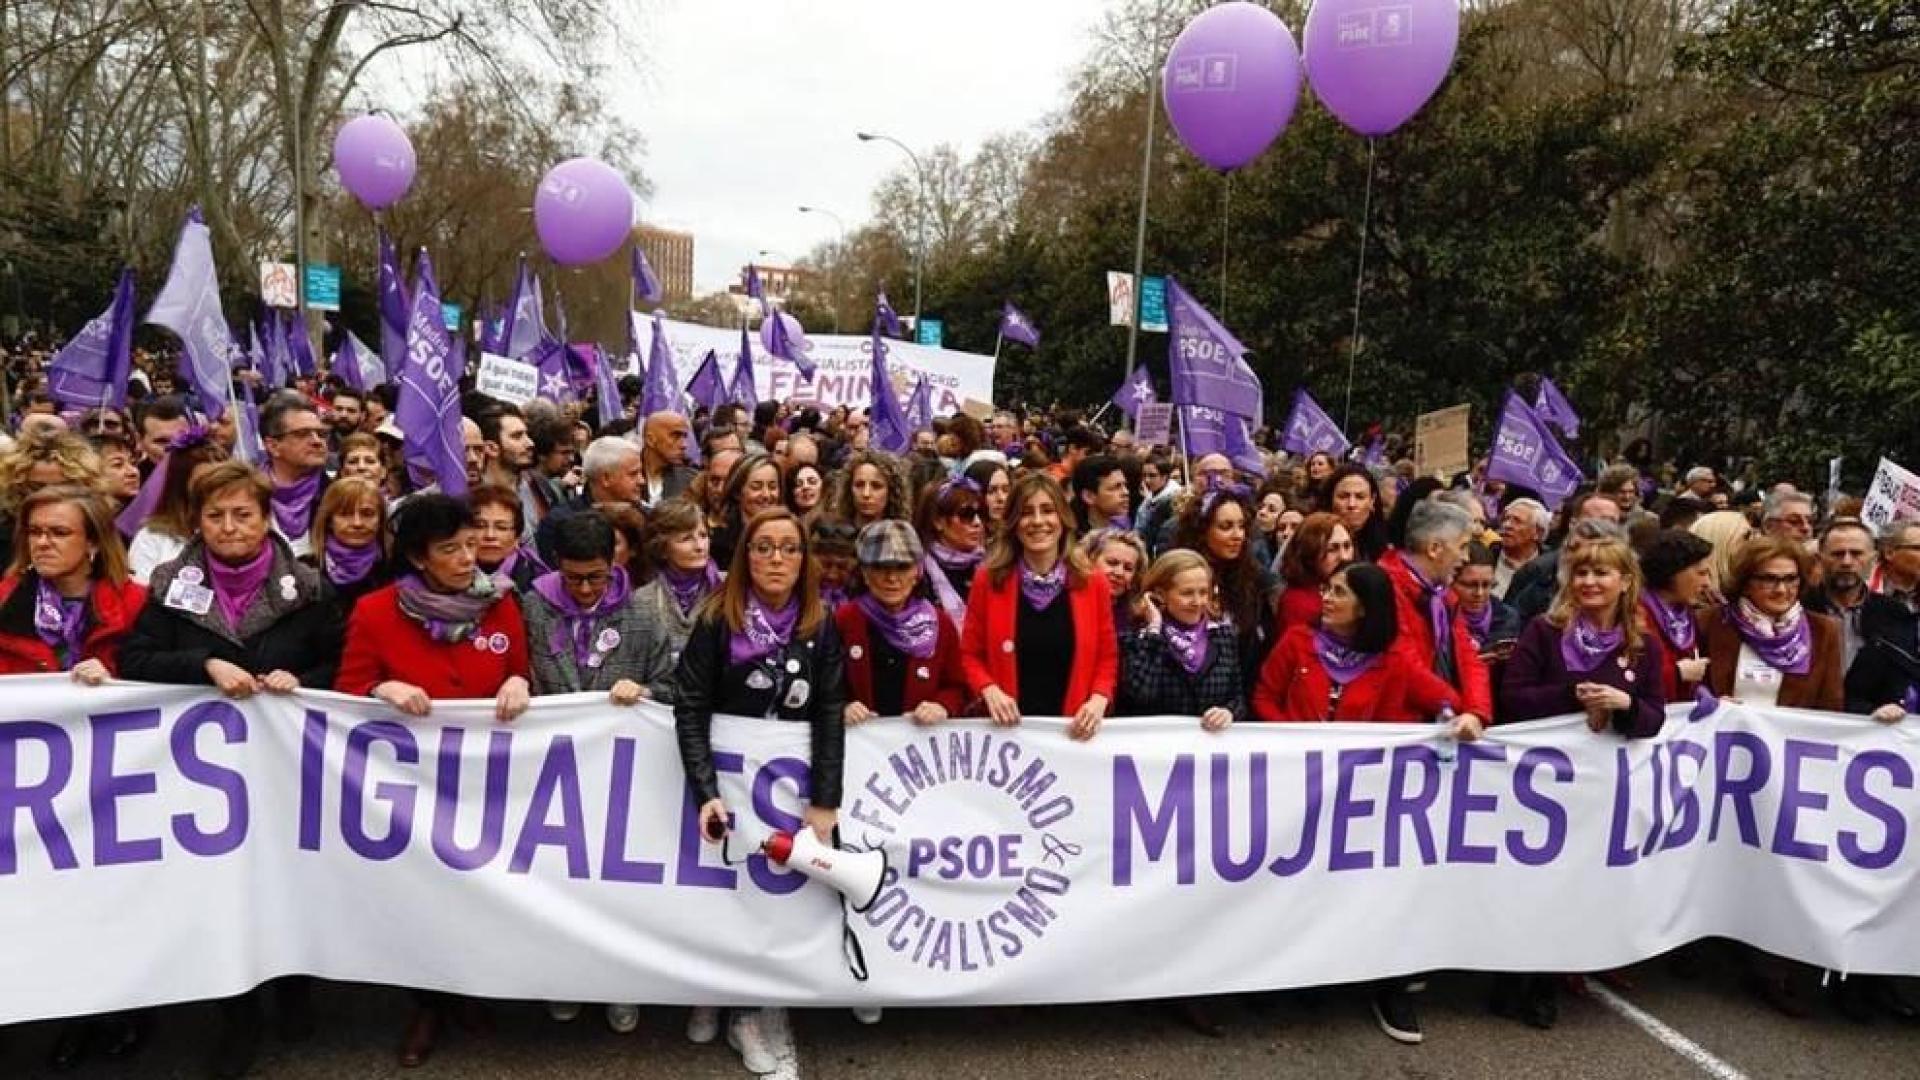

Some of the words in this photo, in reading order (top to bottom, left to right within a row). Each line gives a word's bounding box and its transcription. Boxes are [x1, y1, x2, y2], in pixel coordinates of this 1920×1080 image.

[0, 699, 250, 876] RES
[297, 709, 812, 895] IGUALES
[1111, 744, 1575, 887] MUJERES
[1605, 731, 1915, 870] LIBRES
[849, 731, 1075, 834] FEMINISMO
[907, 834, 1024, 880] PSOE
